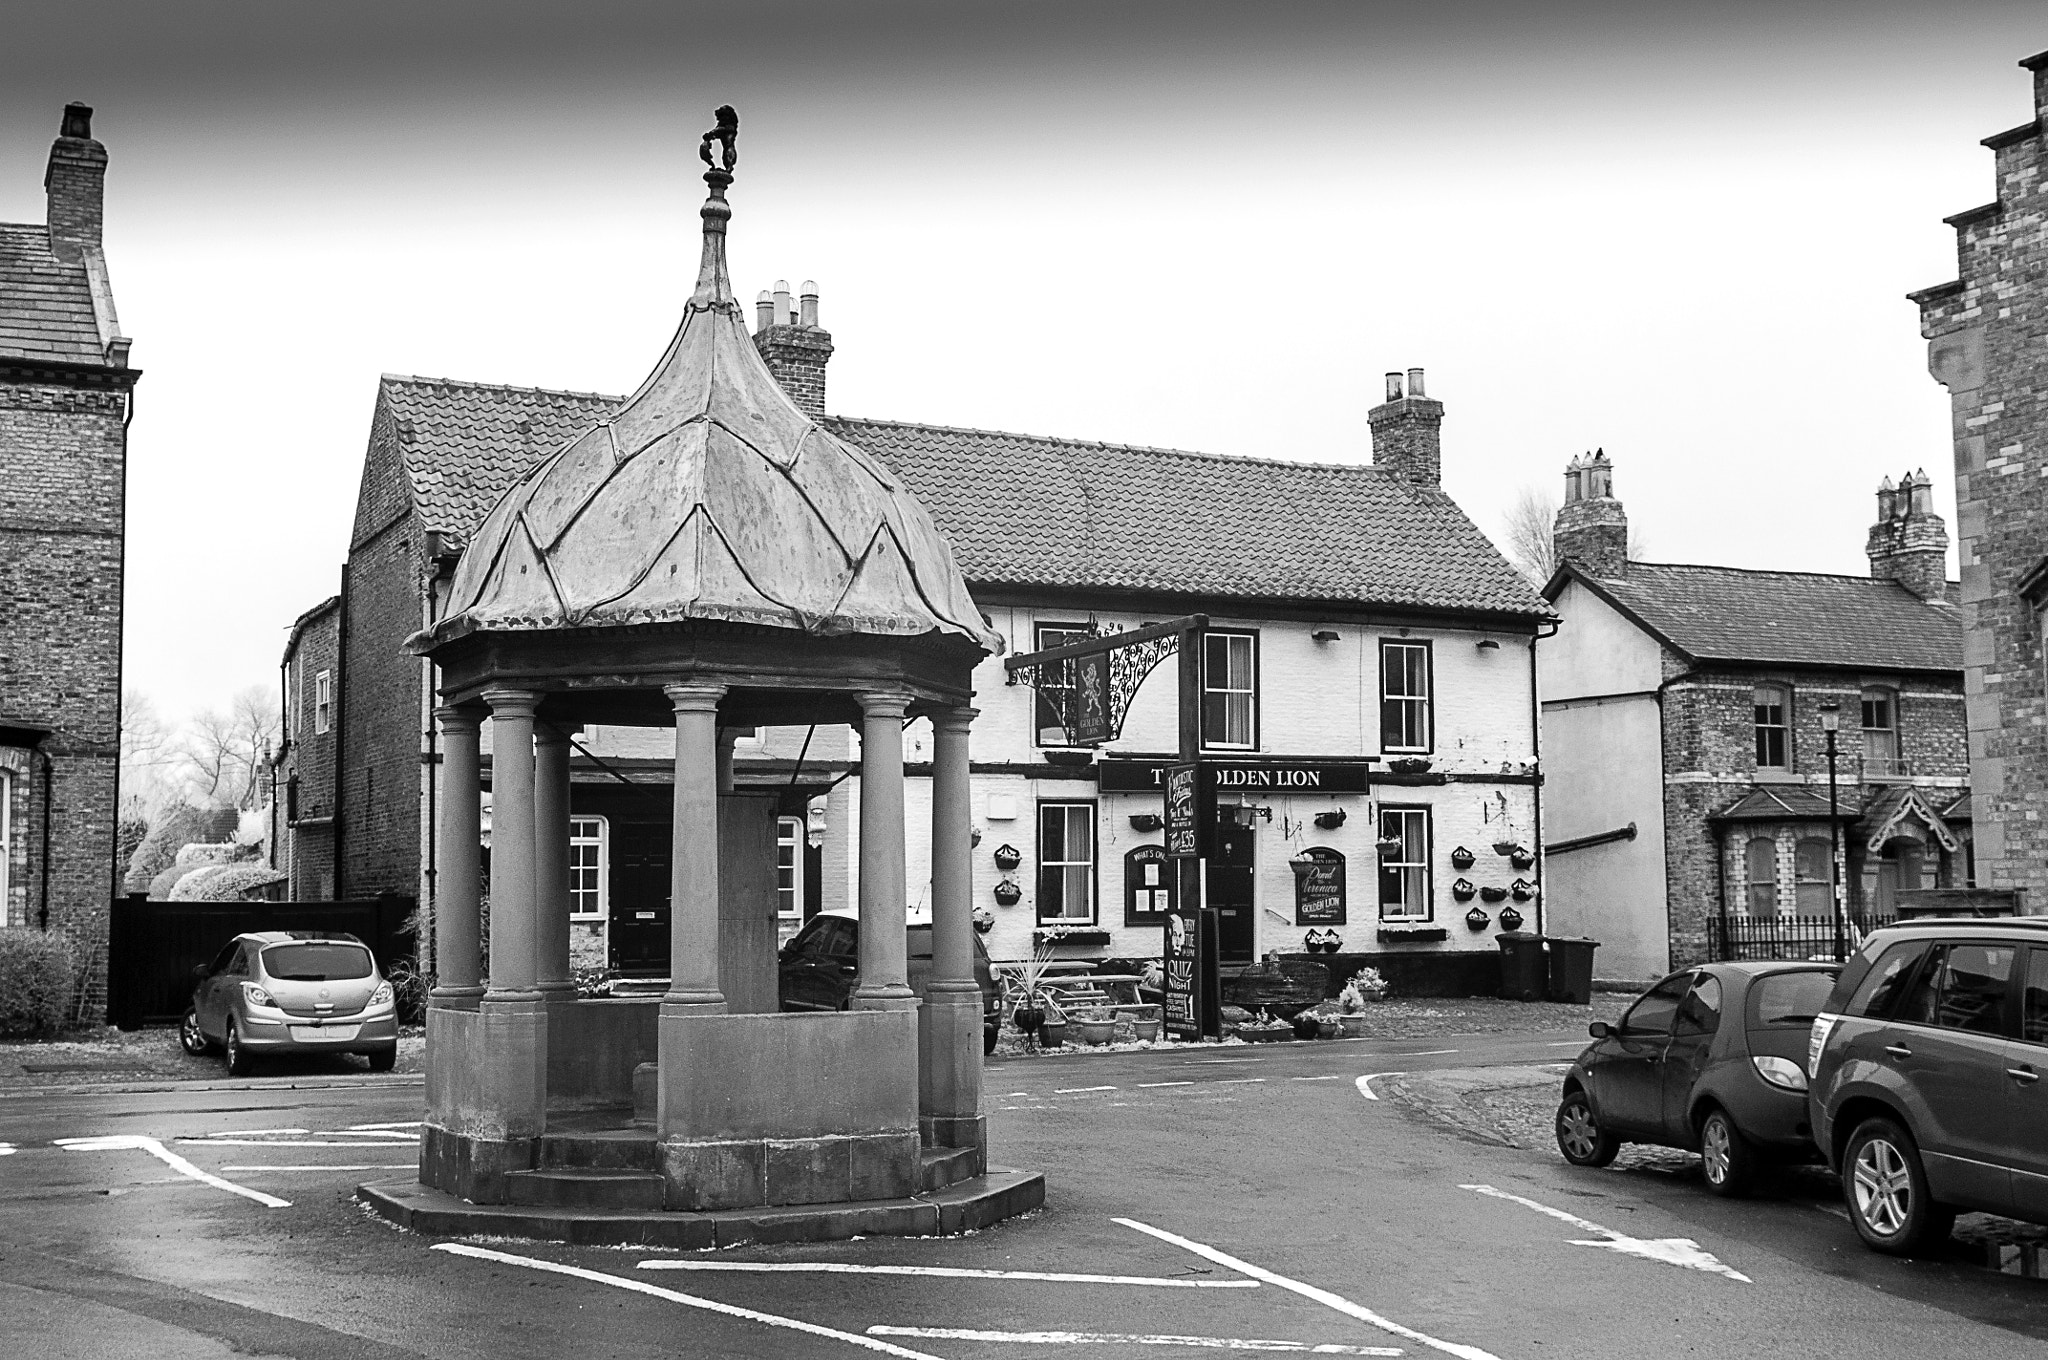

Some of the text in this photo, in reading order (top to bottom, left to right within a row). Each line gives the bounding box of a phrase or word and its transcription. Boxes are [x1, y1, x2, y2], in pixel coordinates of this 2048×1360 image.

[1080, 717, 1104, 728] GOLDEN
[1086, 727, 1098, 735] LION
[1217, 770, 1320, 786] LDEN LION
[1181, 830, 1195, 848] £35
[1134, 849, 1154, 861] WHAT'S
[1302, 880, 1338, 893] Veronica
[1302, 900, 1325, 913] GOLDEN
[1325, 897, 1340, 908] LION
[1168, 960, 1192, 981] QUIZ
[1168, 977, 1192, 990] NIGHT
